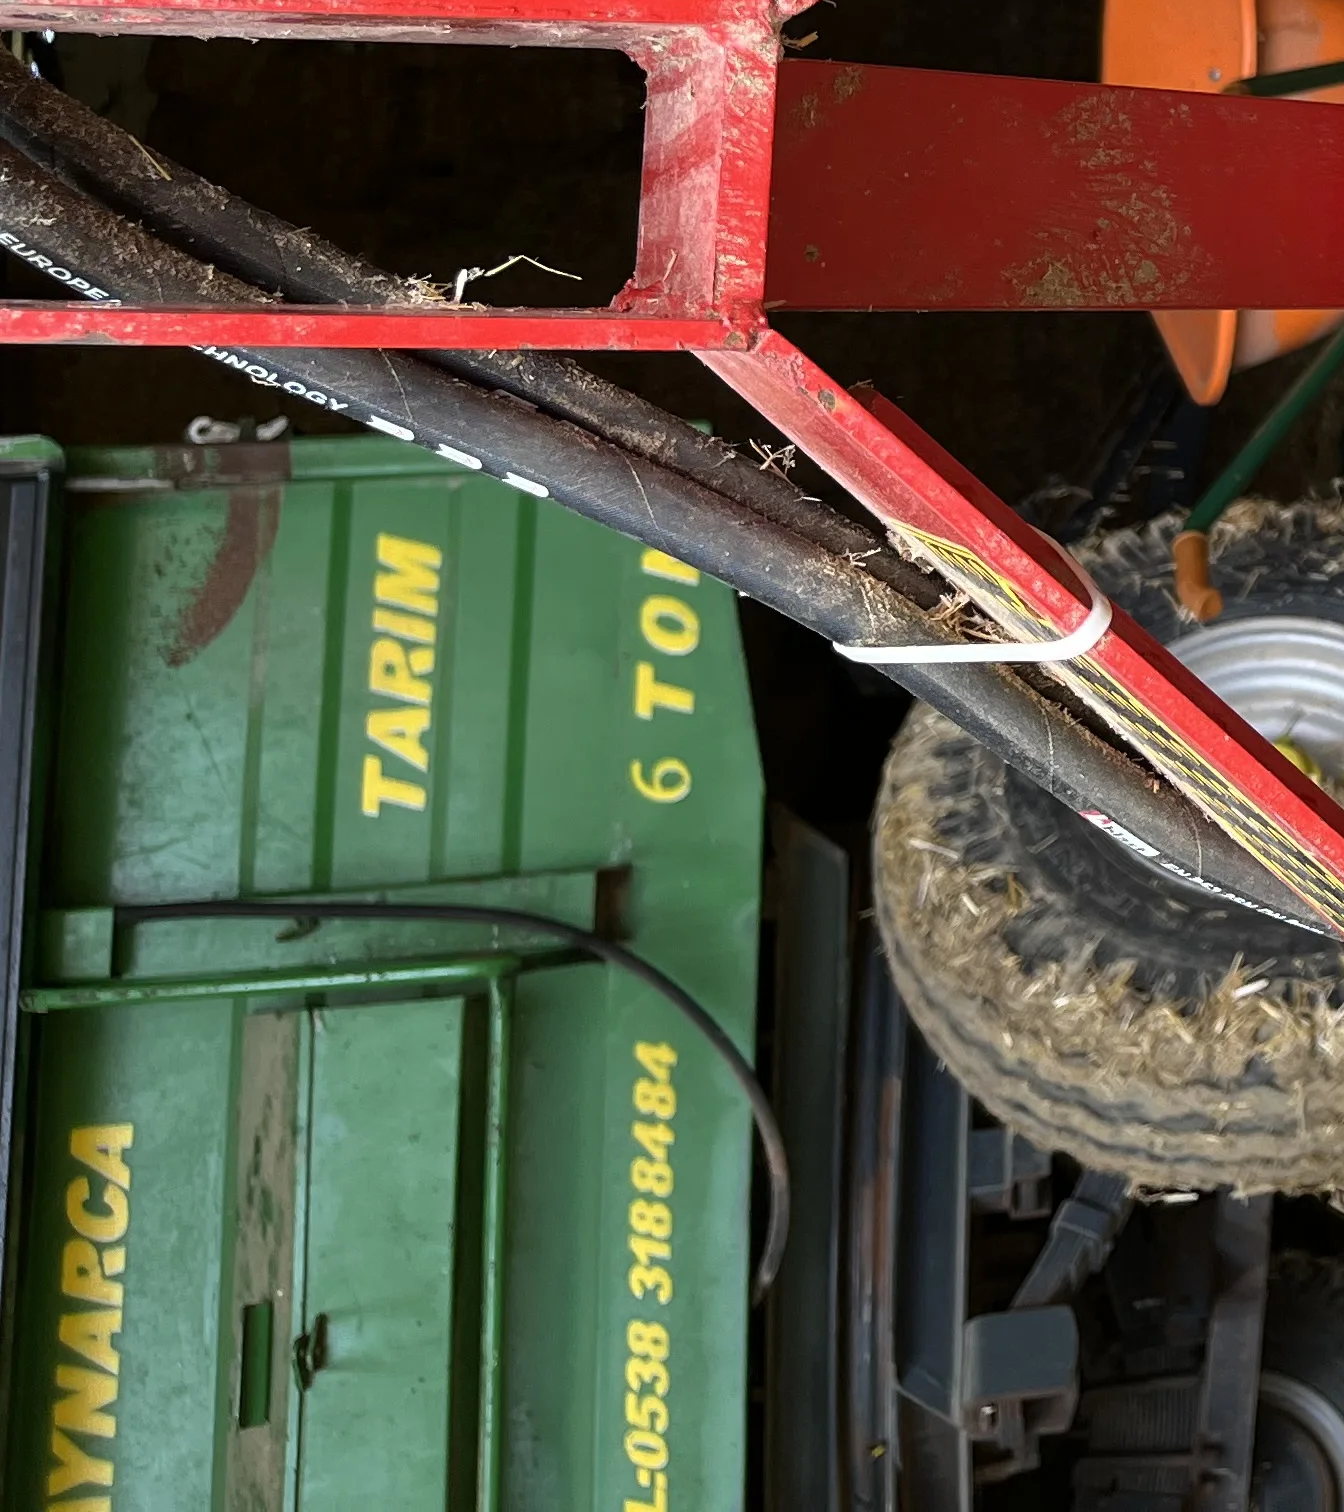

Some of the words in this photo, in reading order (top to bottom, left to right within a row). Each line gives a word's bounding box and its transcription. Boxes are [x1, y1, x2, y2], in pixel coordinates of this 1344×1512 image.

[362, 533, 444, 818] TARIM
[629, 756, 693, 805] 6
[627, 1041, 678, 1305] 3188484
[46, 1123, 134, 1512] YNARCA
